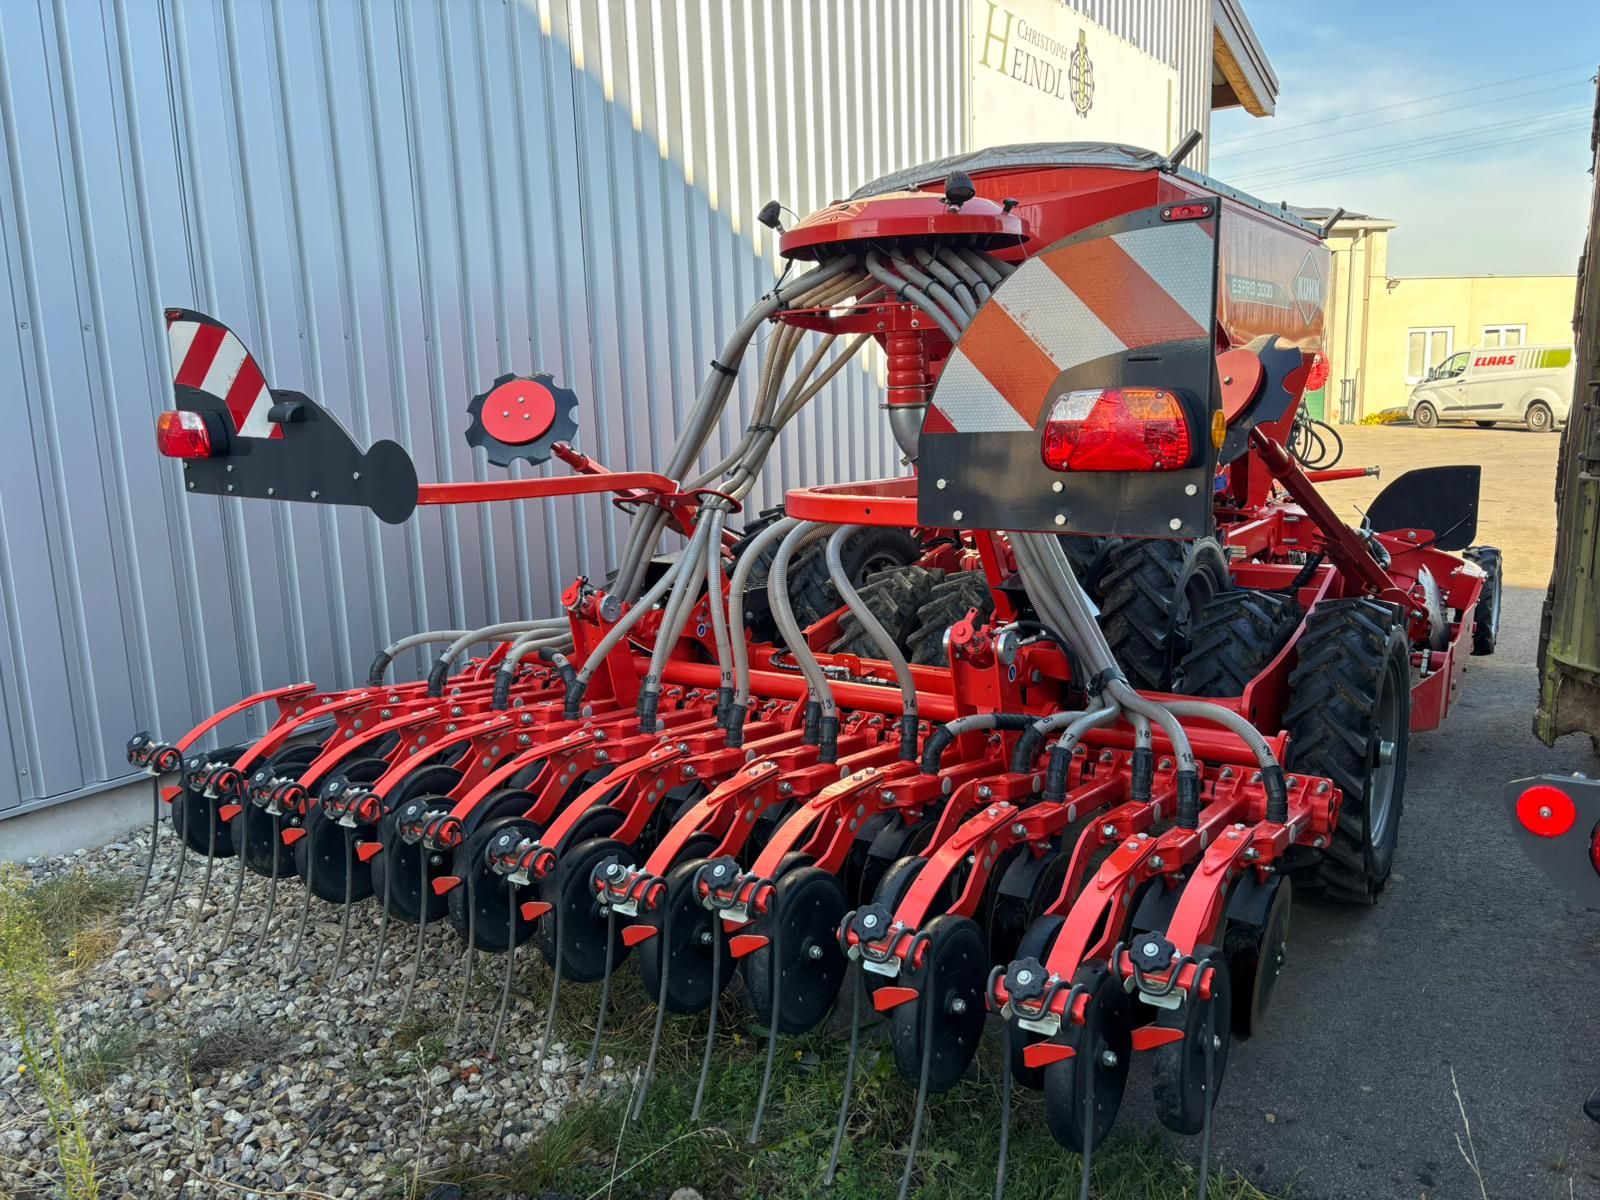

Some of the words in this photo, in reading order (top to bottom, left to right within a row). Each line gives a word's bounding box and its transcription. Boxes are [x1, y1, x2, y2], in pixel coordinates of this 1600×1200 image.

[1017, 19, 1068, 61] CHRISTOPH
[978, 0, 1065, 100] HEINDL
[1231, 278, 1256, 296] ESPRO
[1257, 280, 1273, 298] 3000
[1297, 276, 1320, 302] KUHN
[1473, 355, 1517, 367] CLAAS
[721, 671, 731, 681] 10
[821, 698, 832, 710] 13
[904, 699, 915, 709] 14
[1062, 732, 1075, 742] 17
